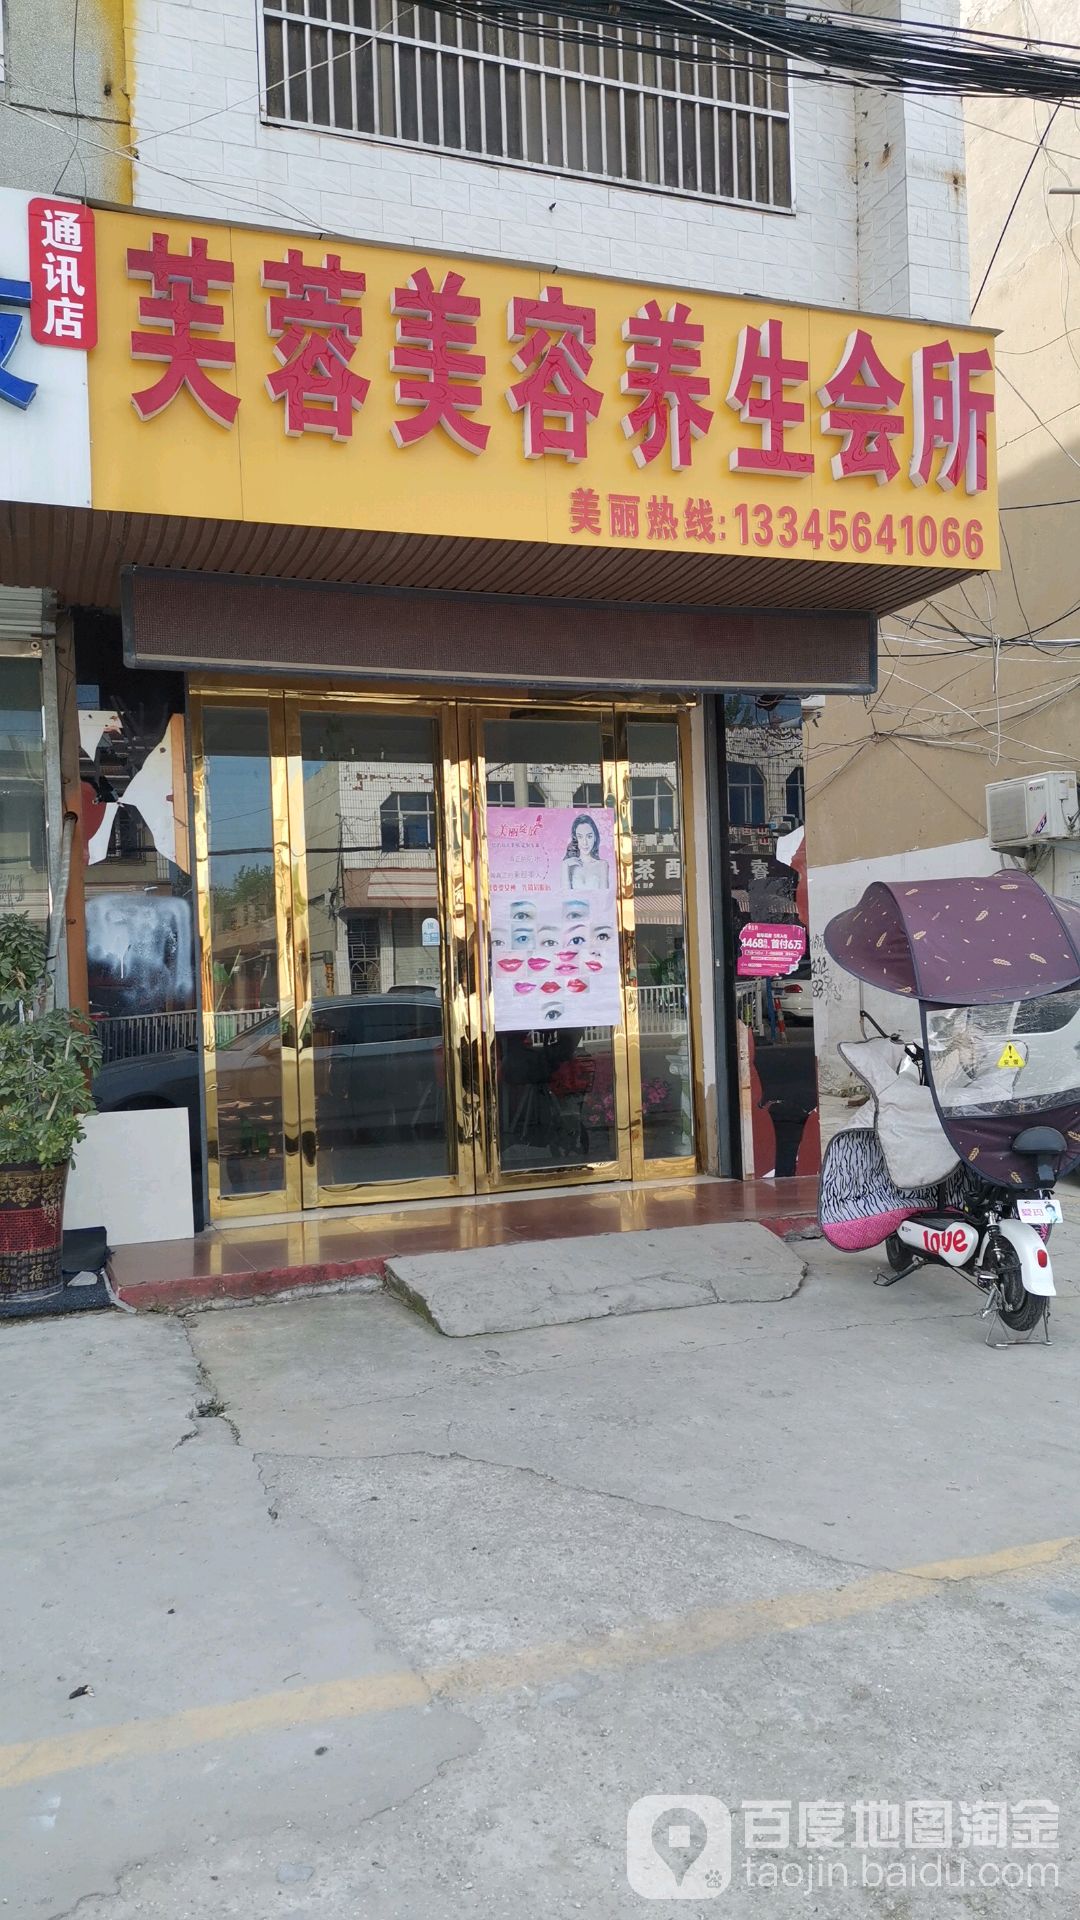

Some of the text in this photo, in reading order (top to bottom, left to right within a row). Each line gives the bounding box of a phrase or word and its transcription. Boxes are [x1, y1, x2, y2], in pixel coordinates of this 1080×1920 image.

[41, 209, 86, 339] 通讯店
[127, 232, 995, 495] 芙蓉美容养生会所
[923, 1228, 968, 1255] love
